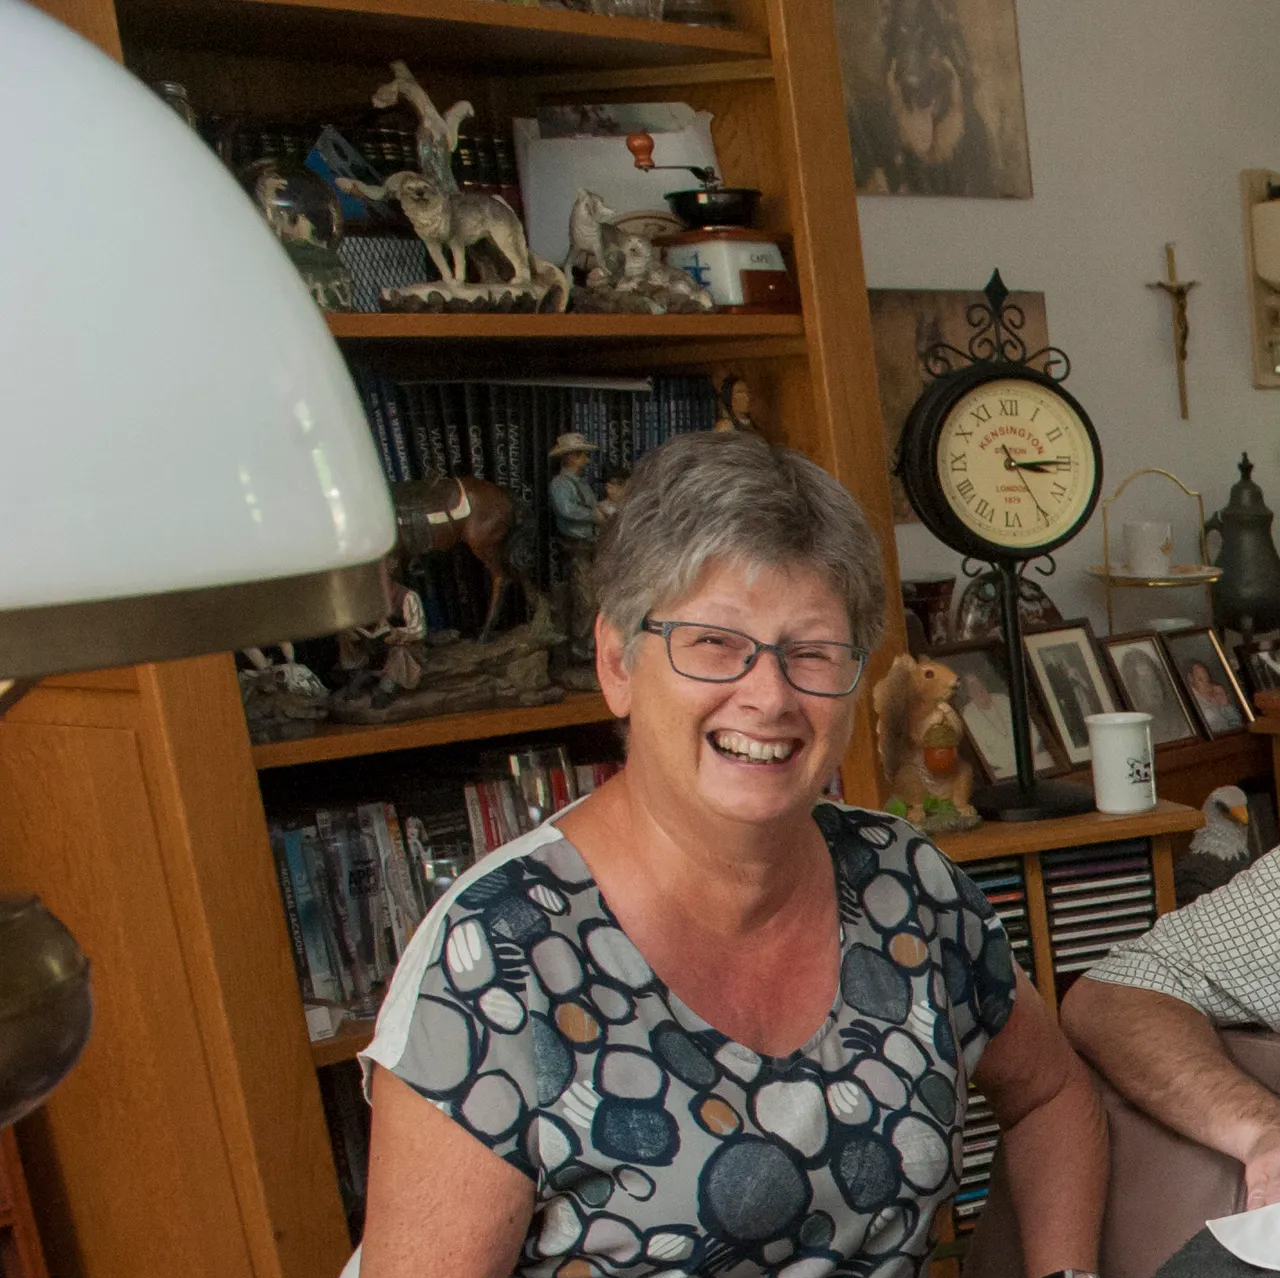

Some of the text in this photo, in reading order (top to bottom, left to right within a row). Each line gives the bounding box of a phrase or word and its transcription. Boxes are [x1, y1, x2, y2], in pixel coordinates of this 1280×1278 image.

[969, 404, 992, 427] XI
[999, 399, 1019, 416] XII
[955, 423, 973, 444] X
[978, 425, 1046, 455] KENSINGTON
[1046, 427, 1063, 443] II
[950, 451, 968, 472] IX
[956, 477, 976, 505] VIII
[1050, 482, 1067, 504] IV
[974, 499, 995, 523] VII
[1004, 511, 1023, 528] VI
[280, 867, 304, 955] MICHAEL JACKSON
